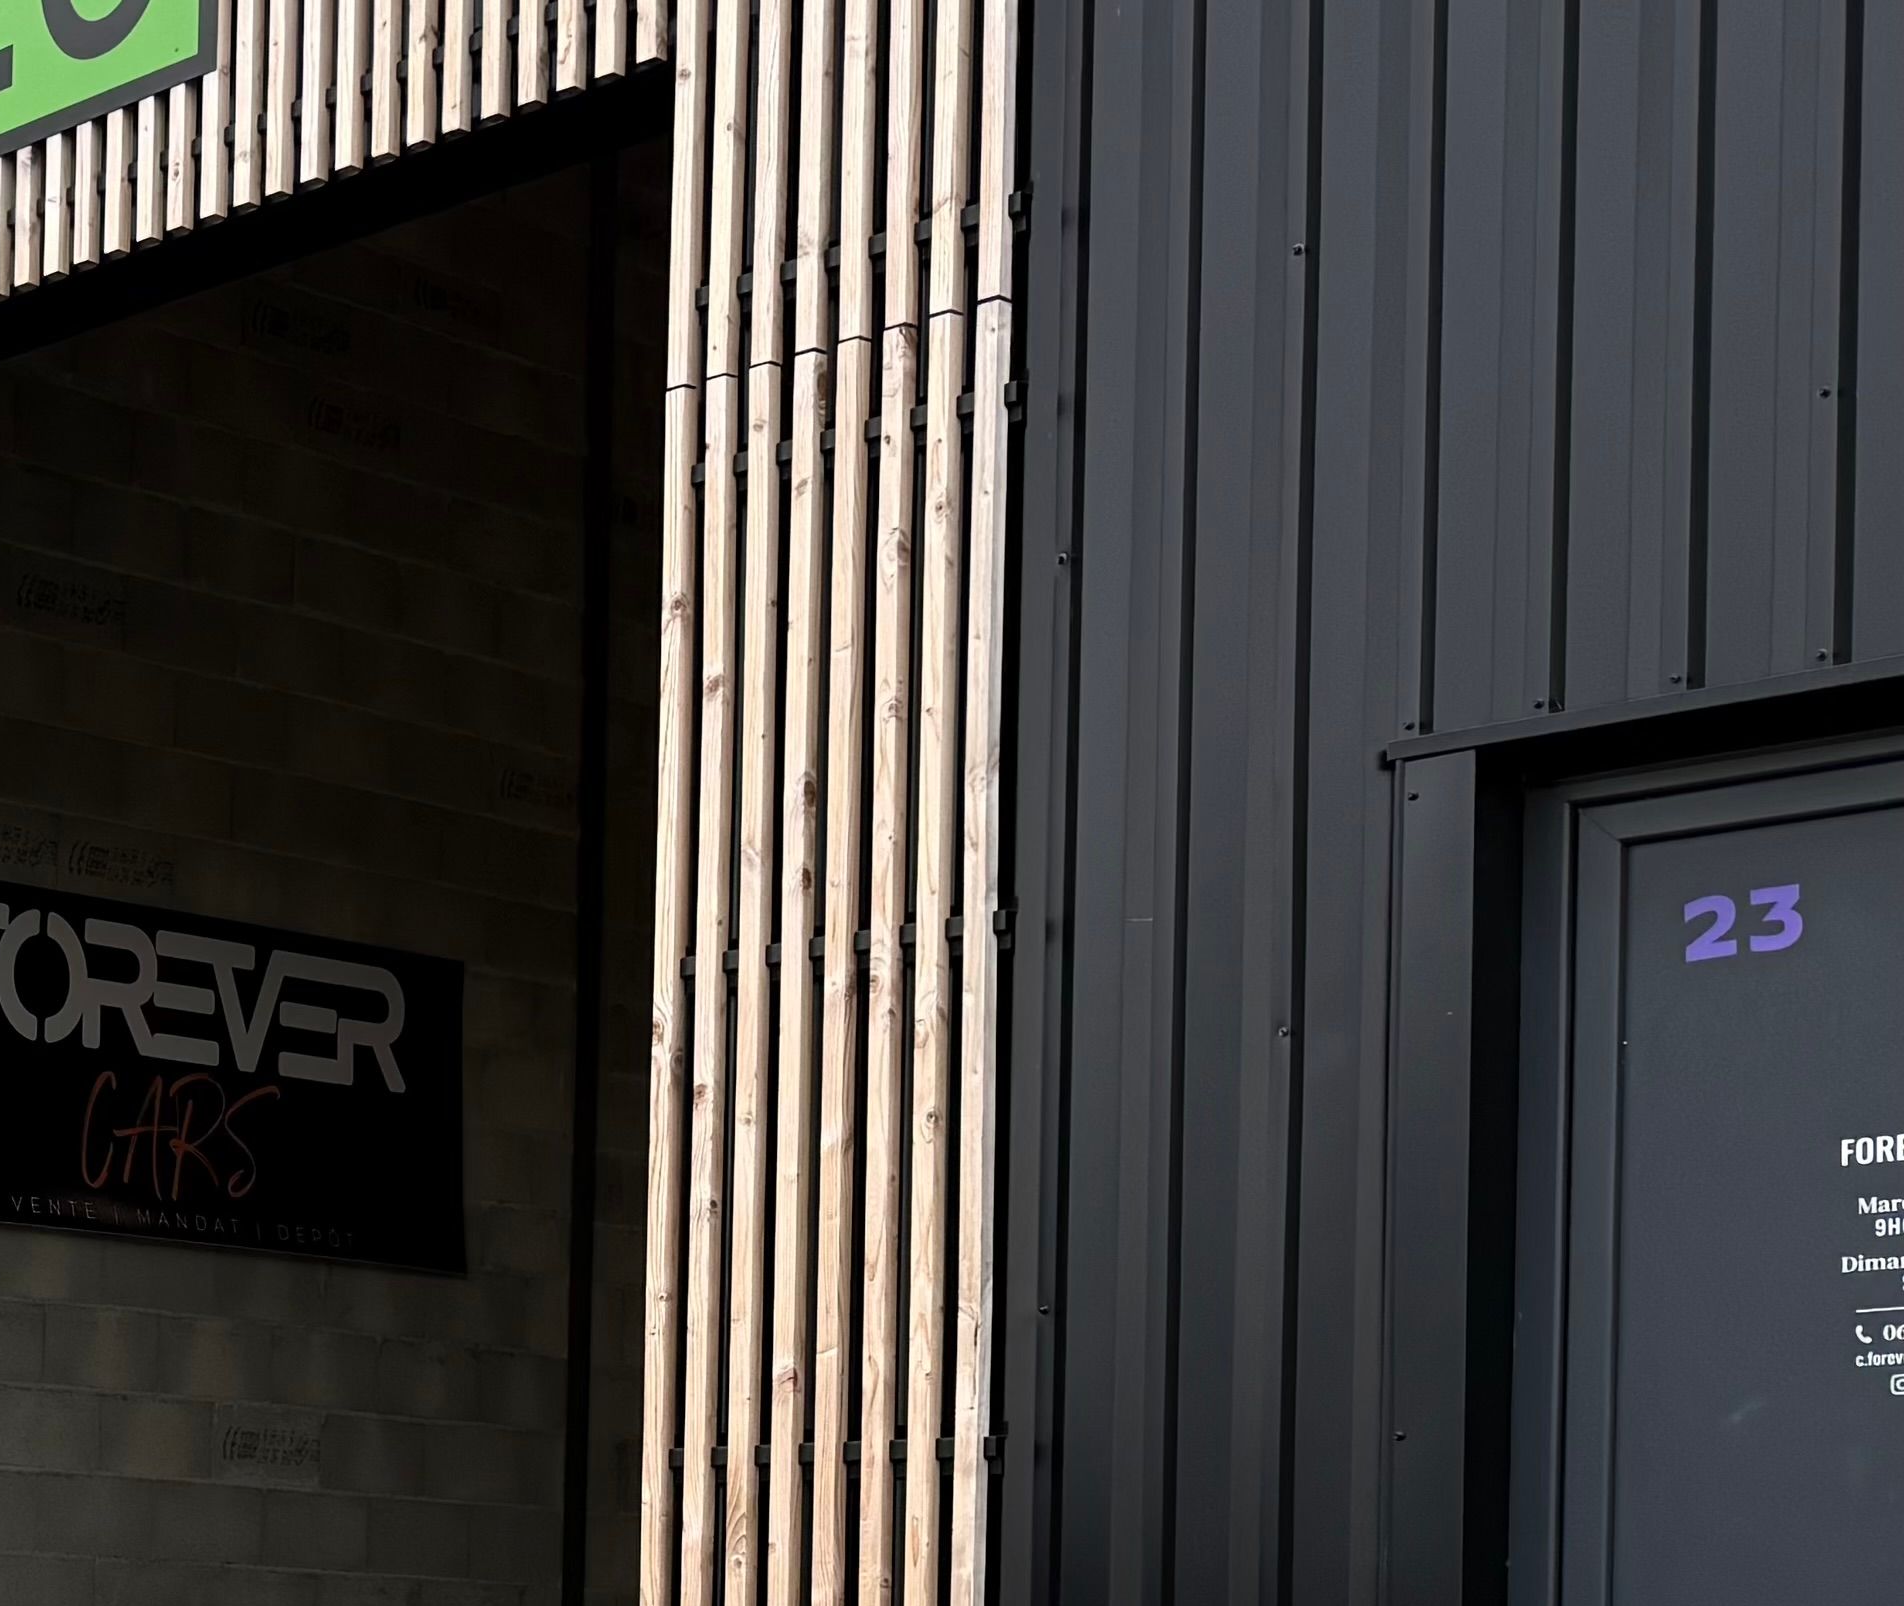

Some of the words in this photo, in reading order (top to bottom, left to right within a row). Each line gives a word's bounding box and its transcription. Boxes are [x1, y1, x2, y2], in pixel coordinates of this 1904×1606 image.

[1684, 884, 1803, 963] 23
[82, 1071, 280, 1201] CARS
[11, 1195, 96, 1220] VENTE
[137, 1208, 241, 1234] MANDAT
[1858, 1196, 1904, 1215] Mar
[1875, 1217, 1904, 1237] 9H
